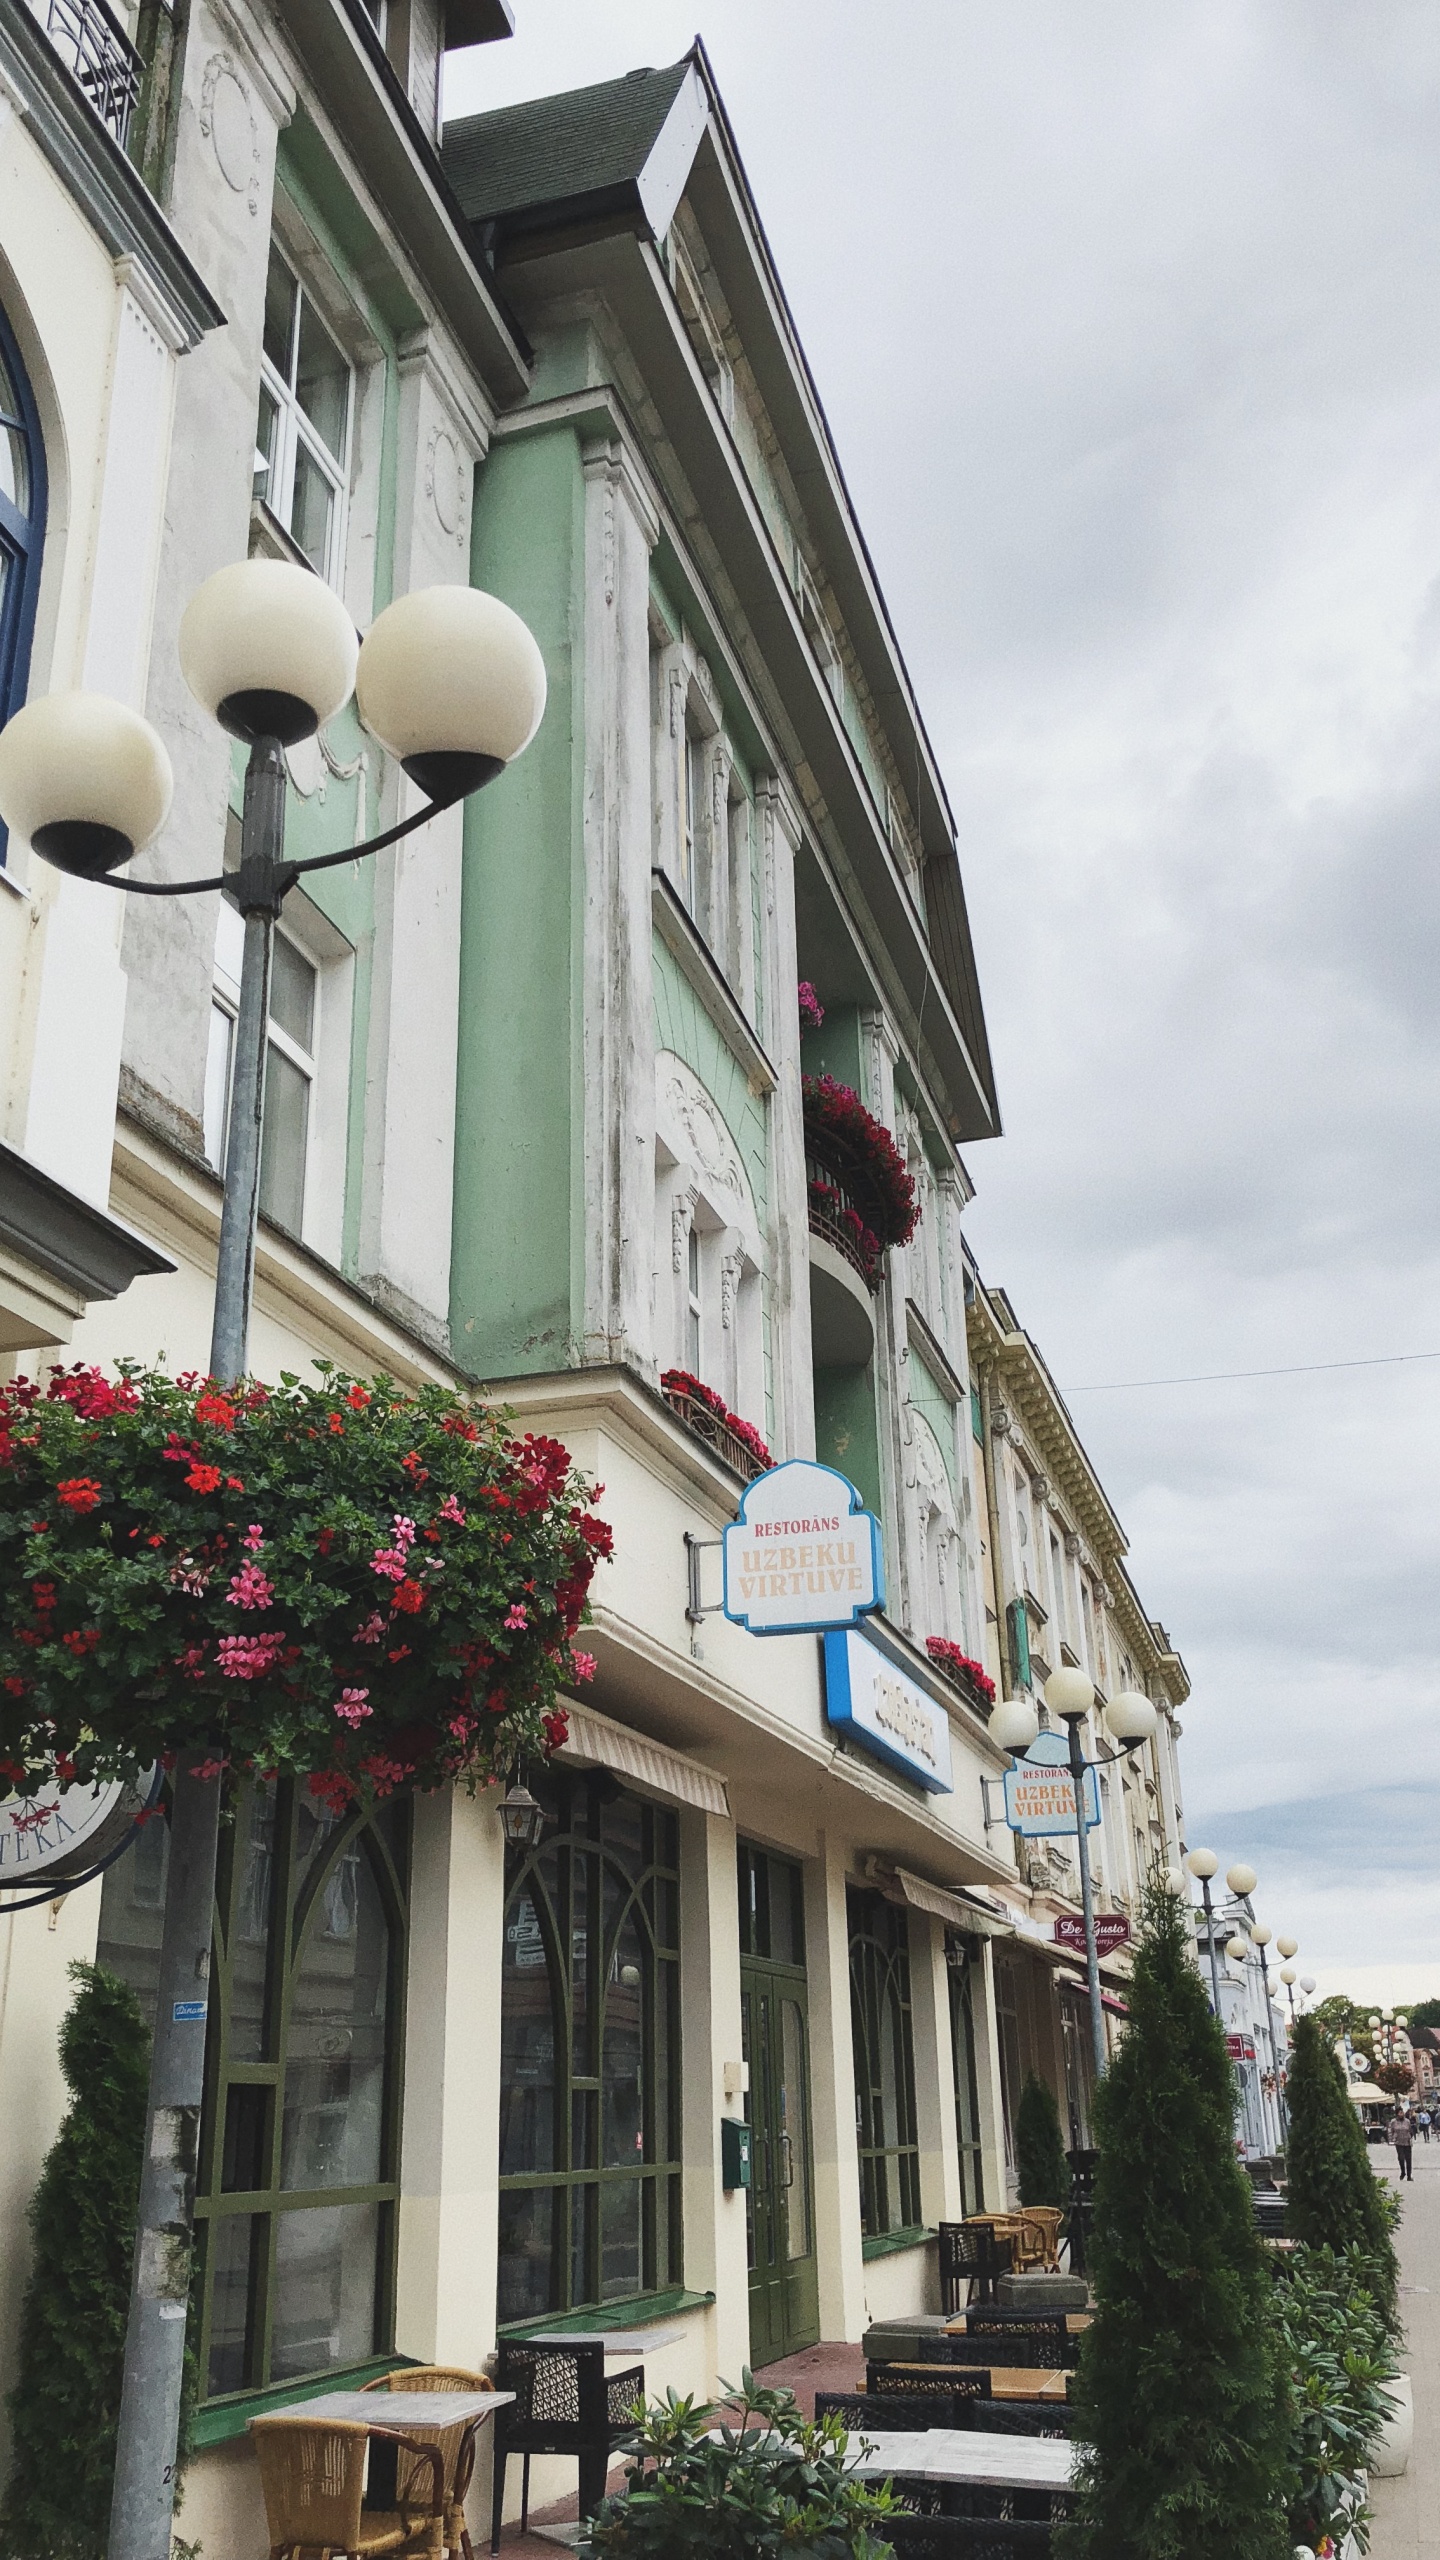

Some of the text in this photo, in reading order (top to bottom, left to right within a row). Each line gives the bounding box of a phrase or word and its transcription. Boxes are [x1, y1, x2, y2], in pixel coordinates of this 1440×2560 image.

[755, 1514, 840, 1537] RESTORĀNS
[742, 1541, 857, 1573] UZBEKU
[738, 1567, 863, 1600] VIRTUVE
[1016, 1784, 1084, 1801] UZBEK
[1061, 1920, 1082, 1935] De
